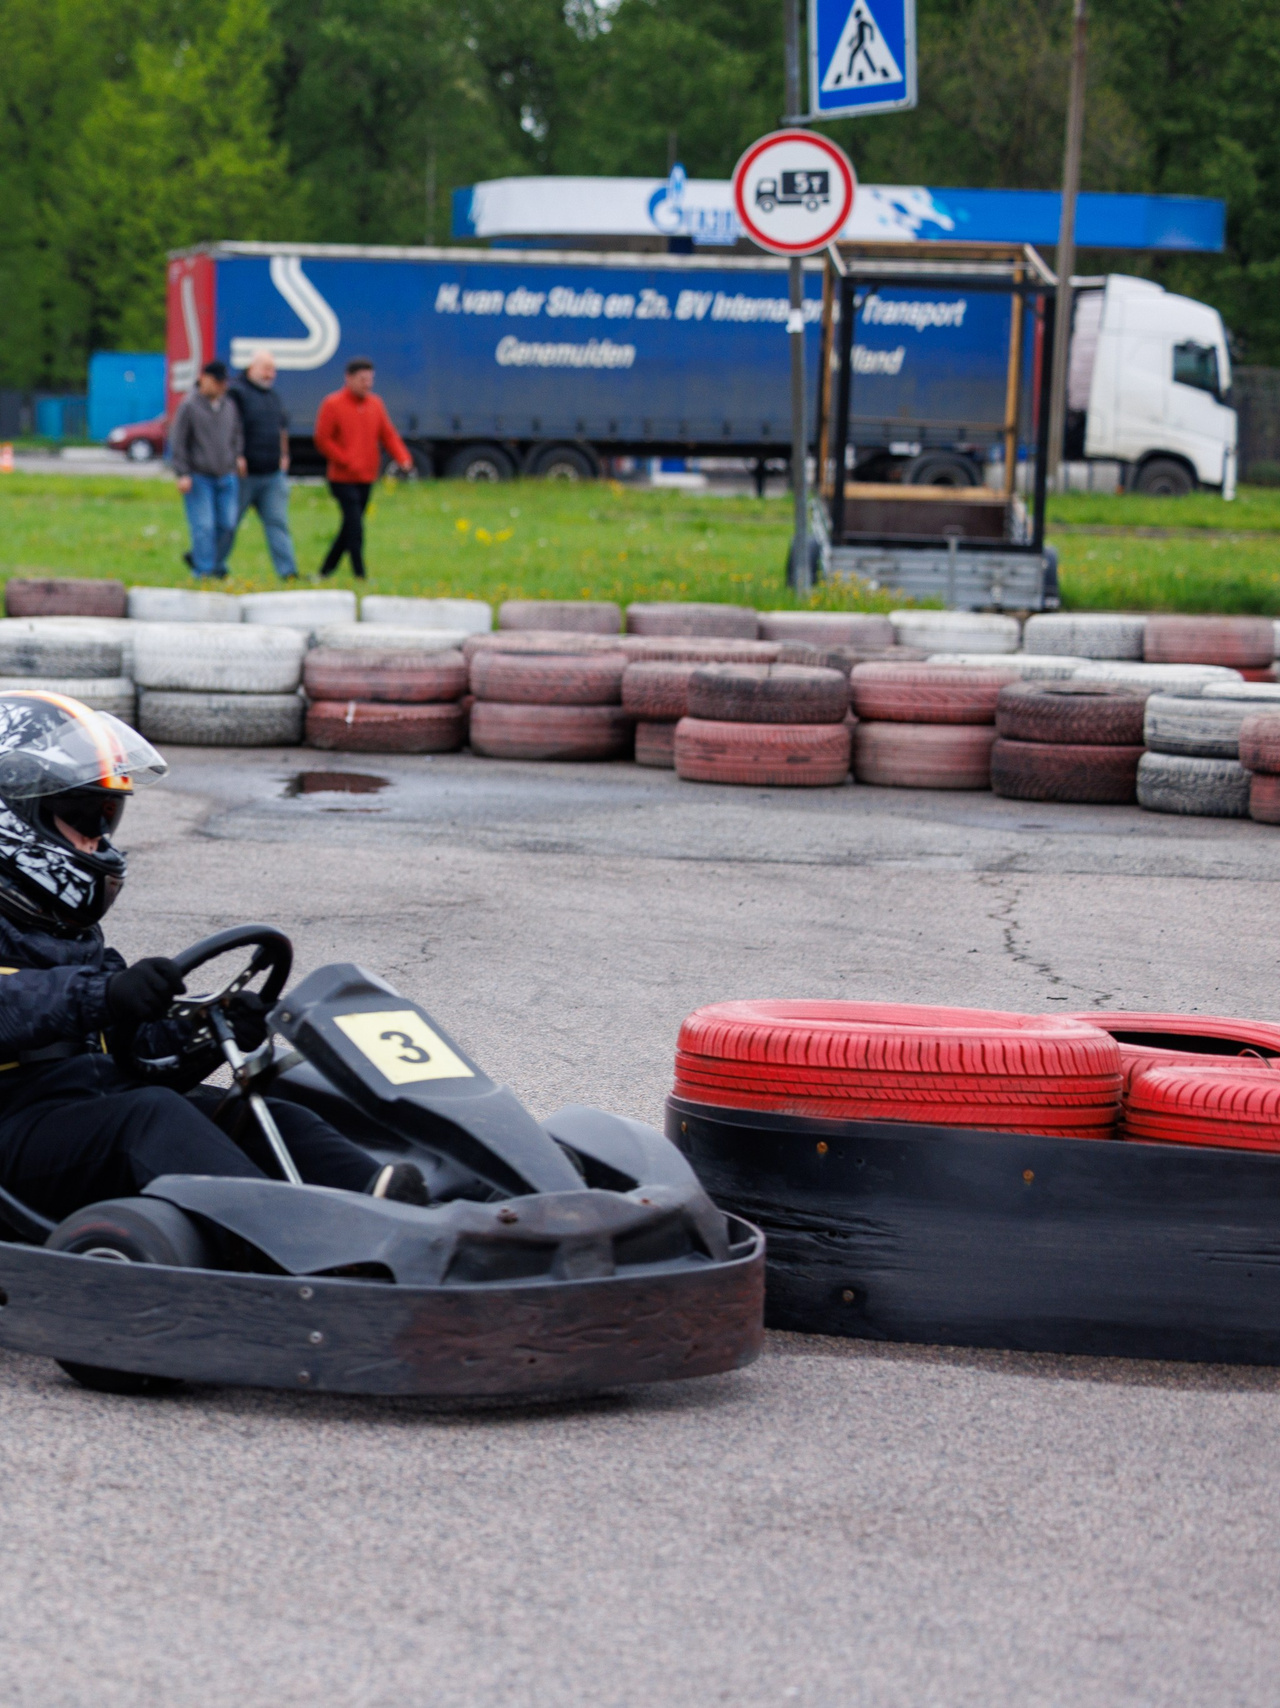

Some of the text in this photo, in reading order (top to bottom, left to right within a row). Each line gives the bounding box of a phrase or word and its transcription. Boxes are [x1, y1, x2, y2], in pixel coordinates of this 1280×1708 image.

[461, 289, 505, 316] van
[504, 285, 547, 317] der
[545, 284, 605, 319] Sluis
[602, 293, 636, 320] en
[674, 288, 714, 322] BV
[862, 294, 967, 333] Transport
[495, 333, 637, 370] Genemuiden
[380, 1031, 431, 1063] 3
